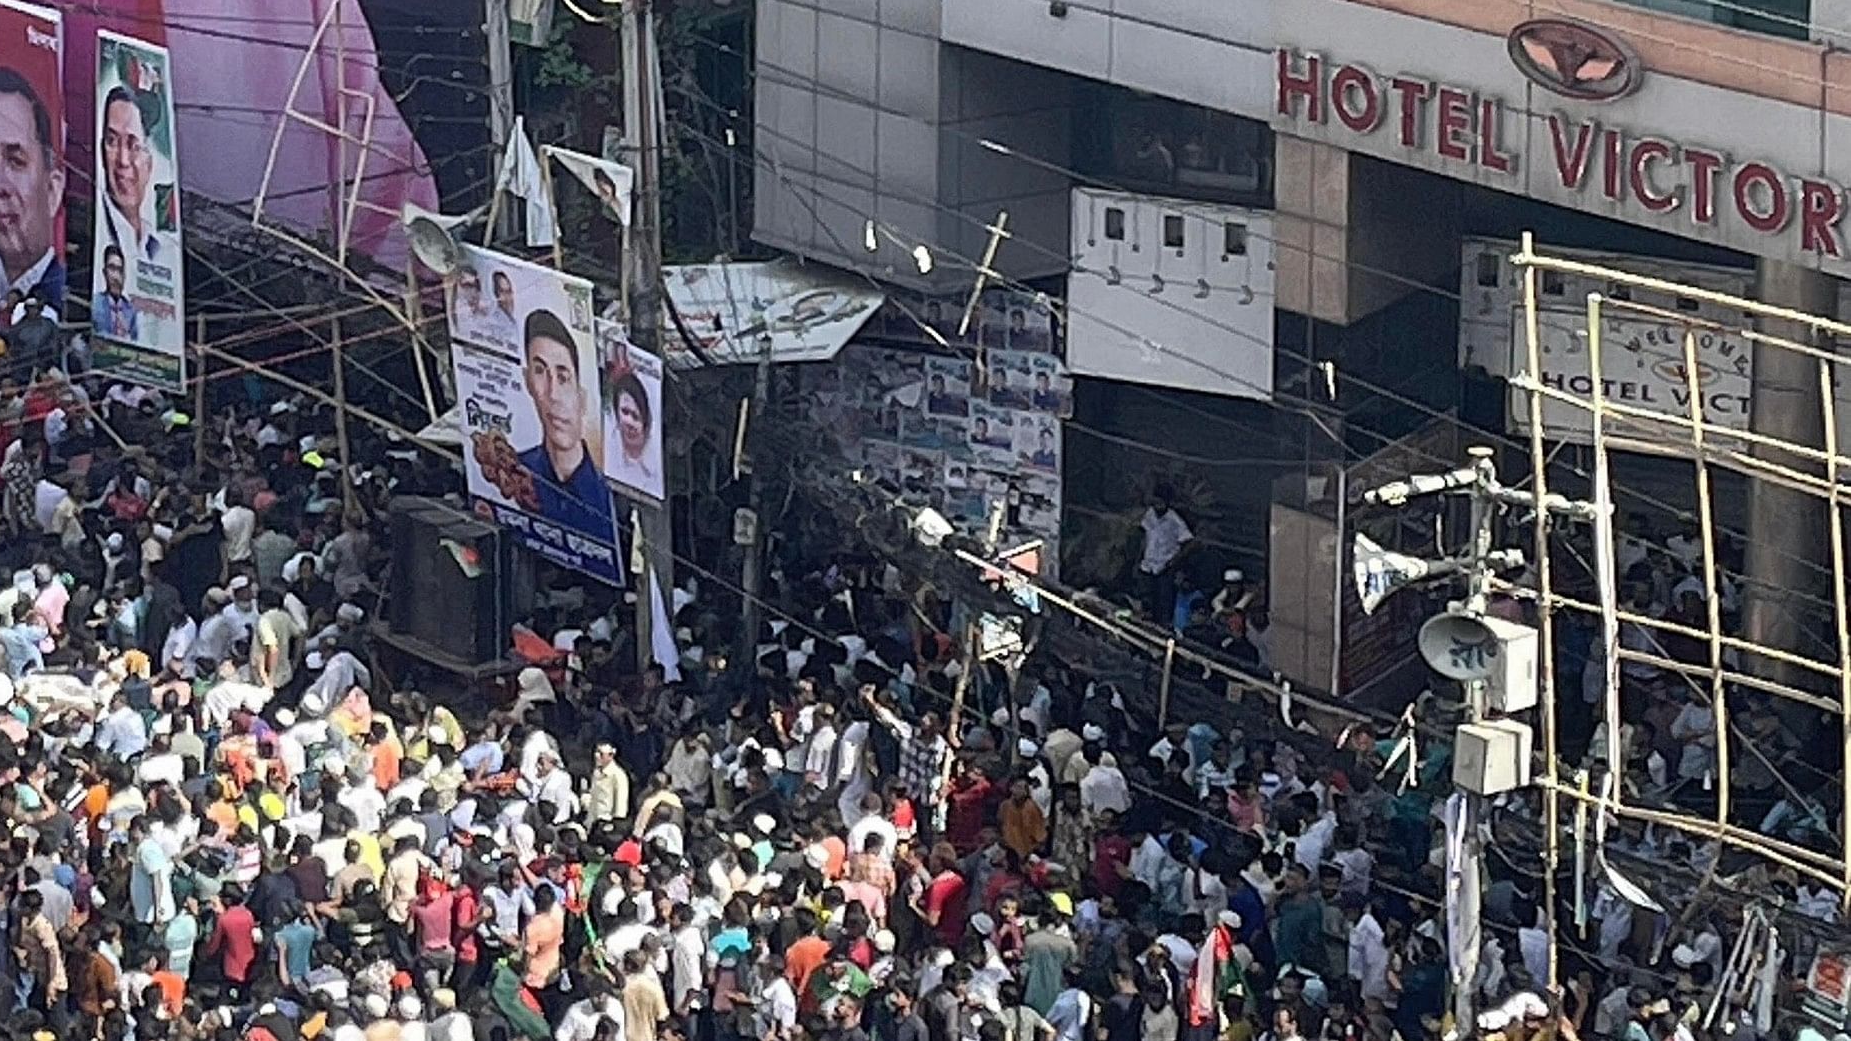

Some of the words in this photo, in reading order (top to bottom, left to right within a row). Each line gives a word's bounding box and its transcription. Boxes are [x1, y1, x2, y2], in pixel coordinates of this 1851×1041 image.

[1276, 47, 1511, 174] HOTEL
[1550, 113, 1842, 257] VICTOR
[1625, 325, 1748, 374] WELOME
[1541, 370, 1657, 403] HOTEL
